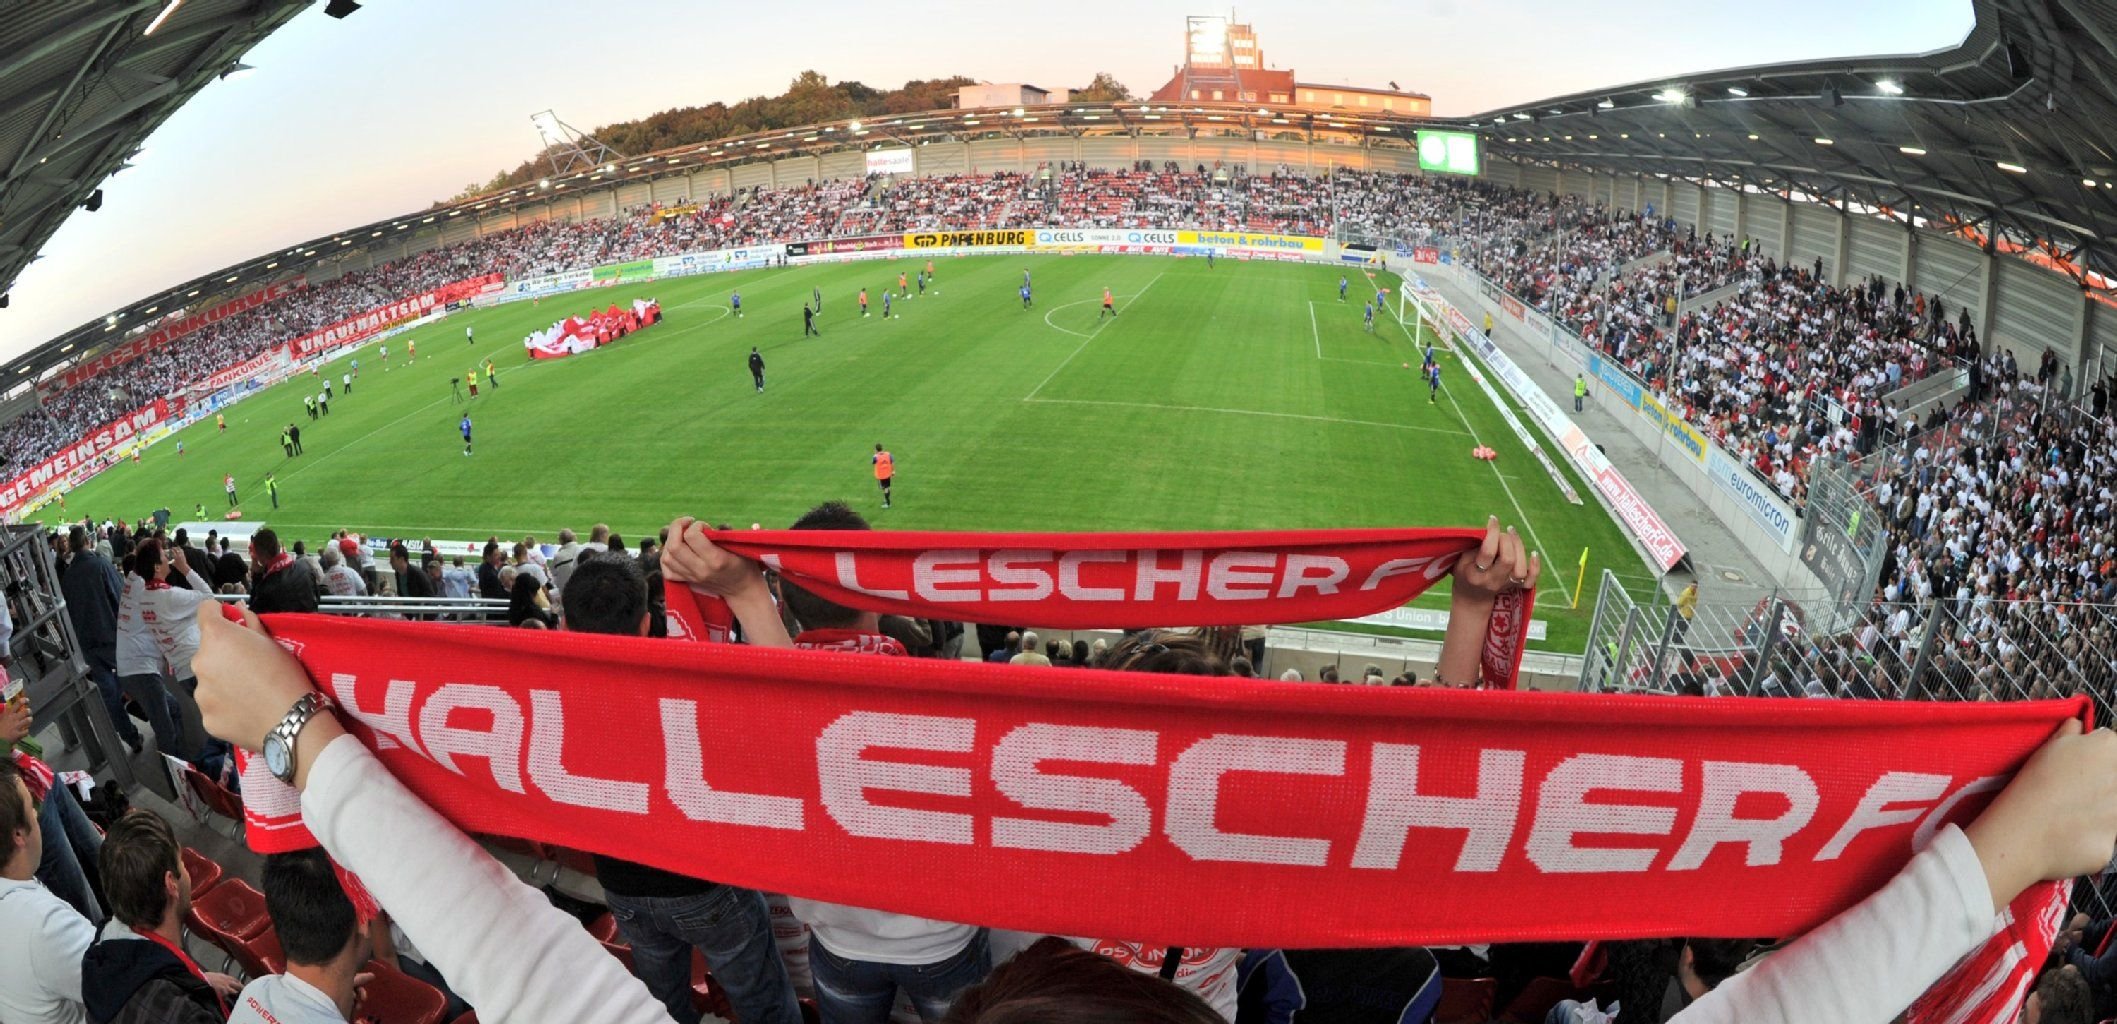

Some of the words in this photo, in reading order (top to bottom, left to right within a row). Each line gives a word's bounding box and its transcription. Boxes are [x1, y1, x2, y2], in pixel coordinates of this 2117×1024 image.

[941, 231, 1025, 247] PAPENBURG
[1197, 232, 1235, 245] beton
[1238, 234, 1248, 245] &
[1251, 236, 1304, 249] rohrbau
[300, 293, 436, 353] UNAUFHALTSAM
[210, 353, 272, 388] FANKURVE
[0, 407, 157, 507] GEMEINSAM
[1396, 608, 1432, 623] Union
[331, 672, 1821, 874] HALLESCHER
[246, 996, 281, 1024] POWER
